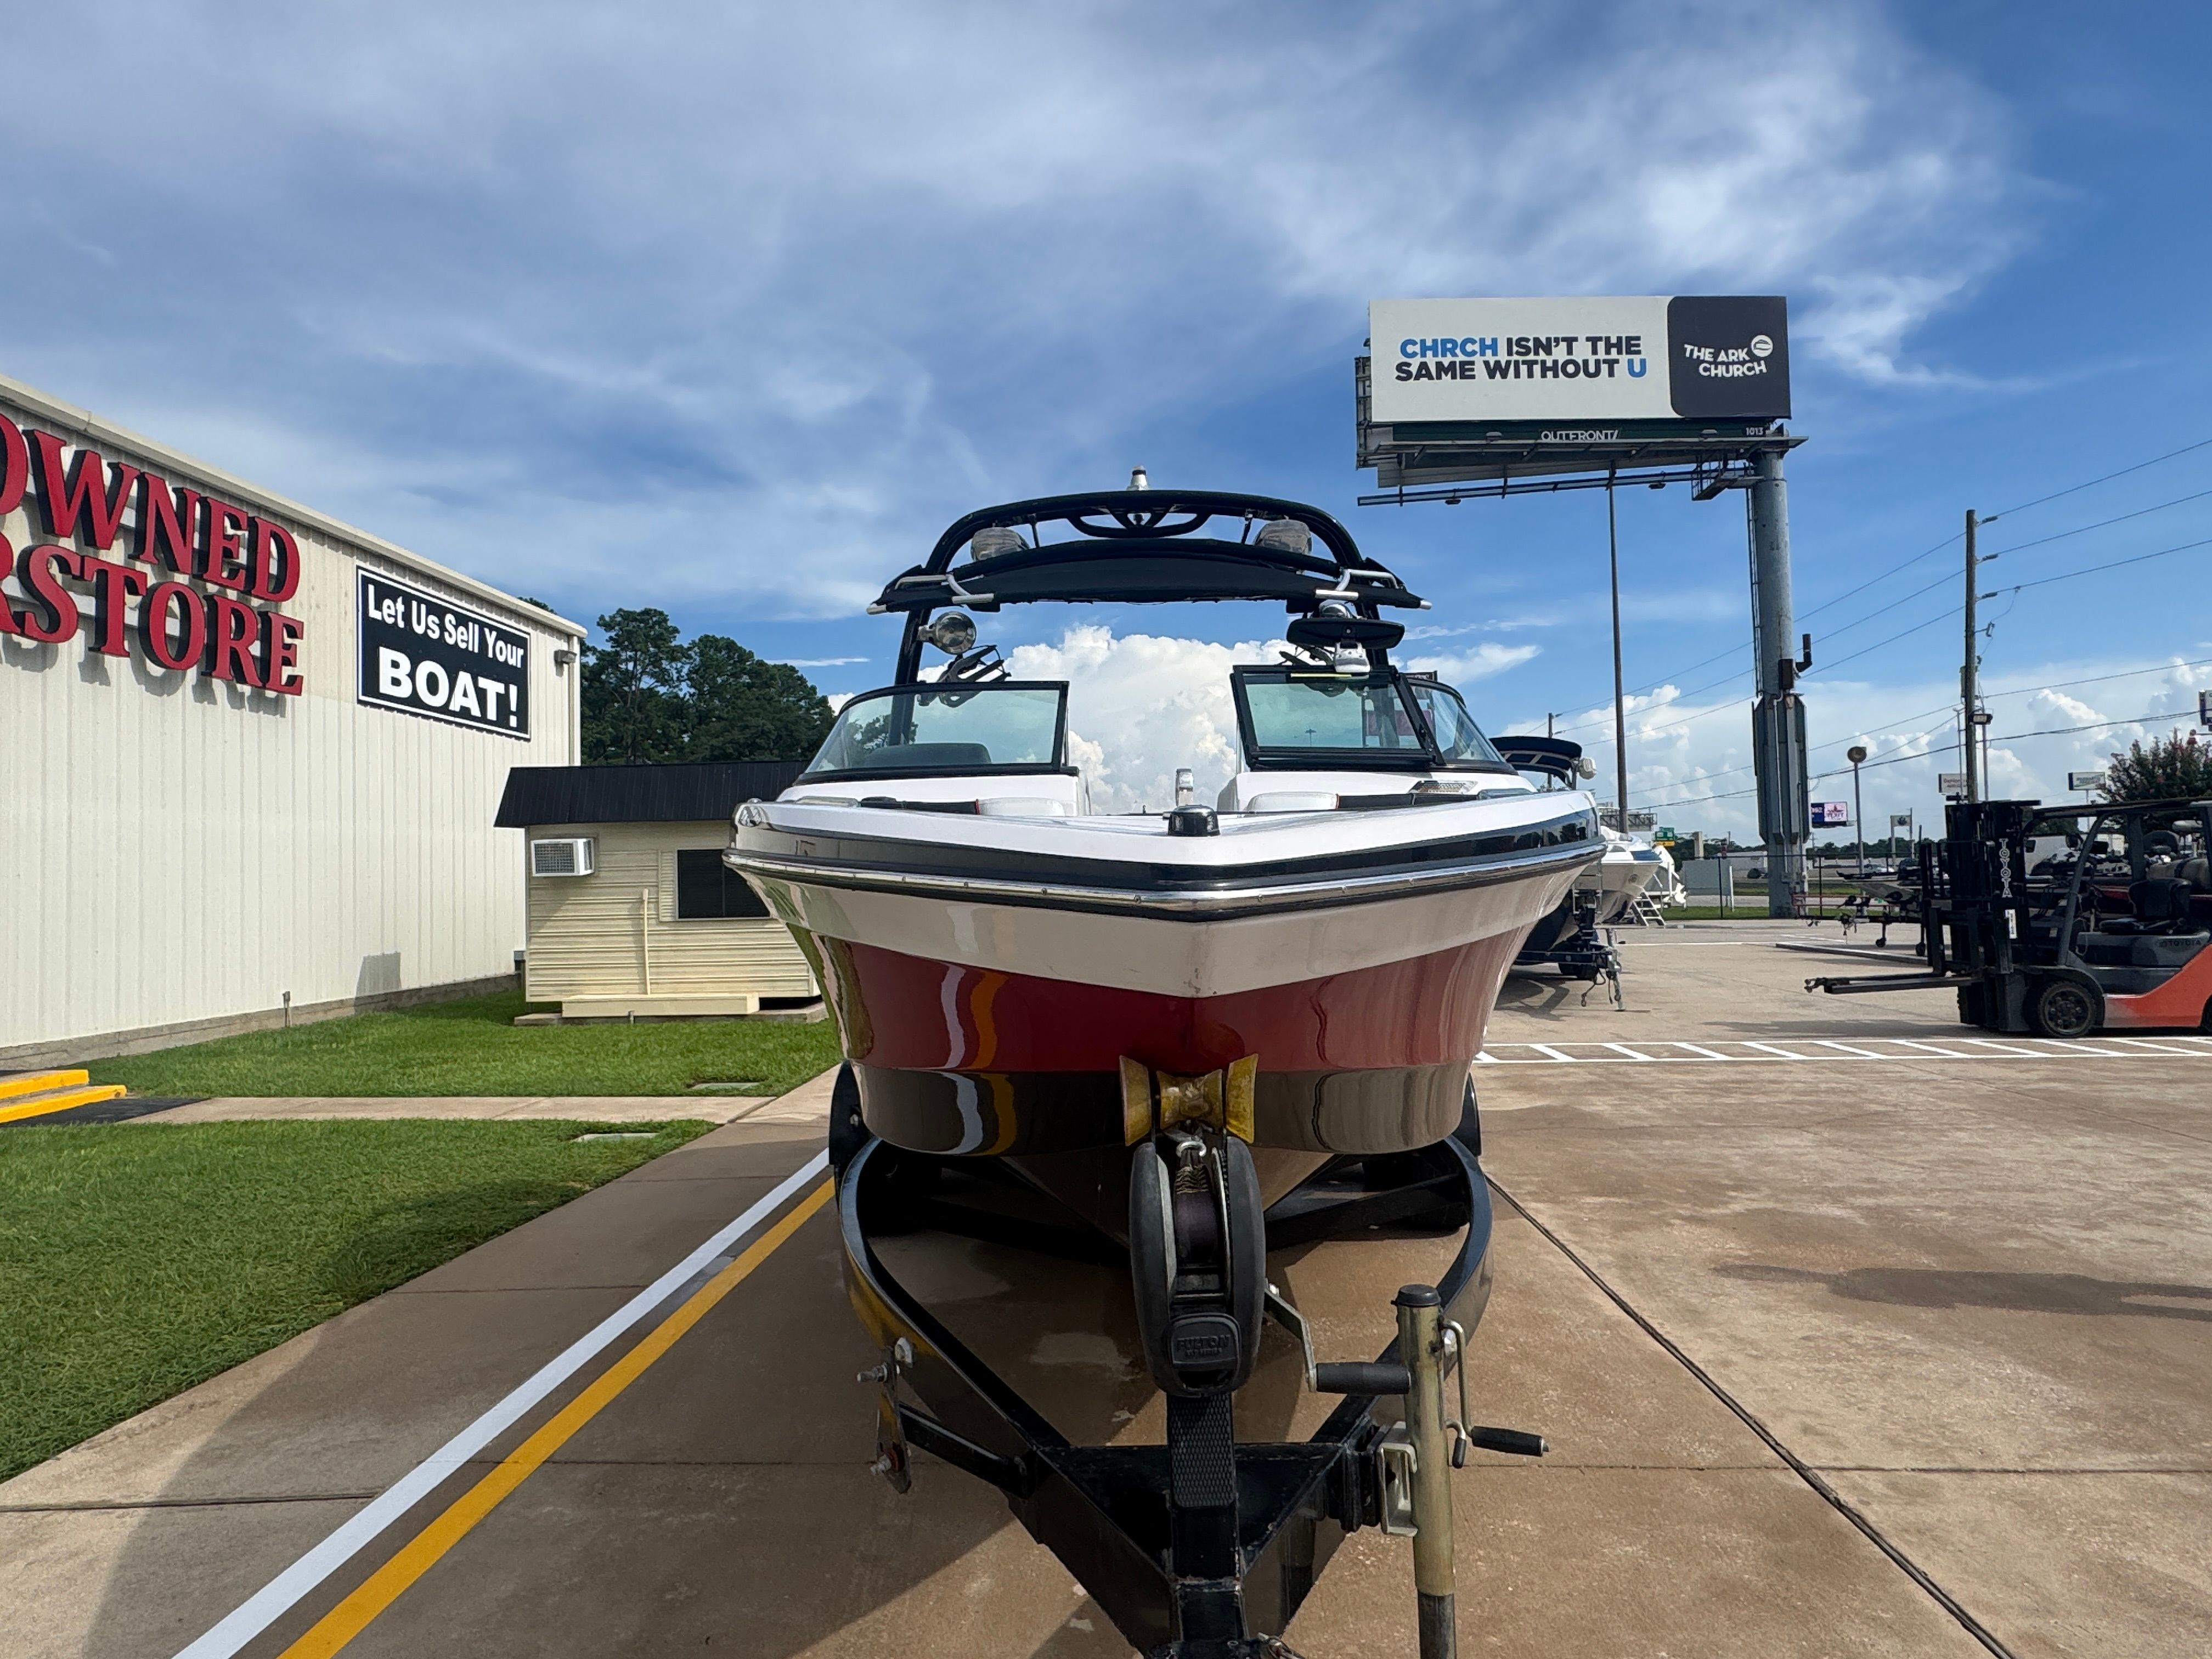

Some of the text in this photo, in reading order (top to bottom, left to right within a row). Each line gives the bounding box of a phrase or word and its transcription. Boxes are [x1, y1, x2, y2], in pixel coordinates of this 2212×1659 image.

[1400, 335, 1641, 358] CHRCH ISN'T THE
[1684, 344, 1750, 362] THE ARK
[1395, 358, 1646, 381] SAME WITHOUT U
[1699, 360, 1767, 377] CHURCH
[368, 584, 524, 668] Let Us Sell Your
[379, 646, 518, 727] BOAT!
[1999, 838, 2013, 898] TOYOTA
